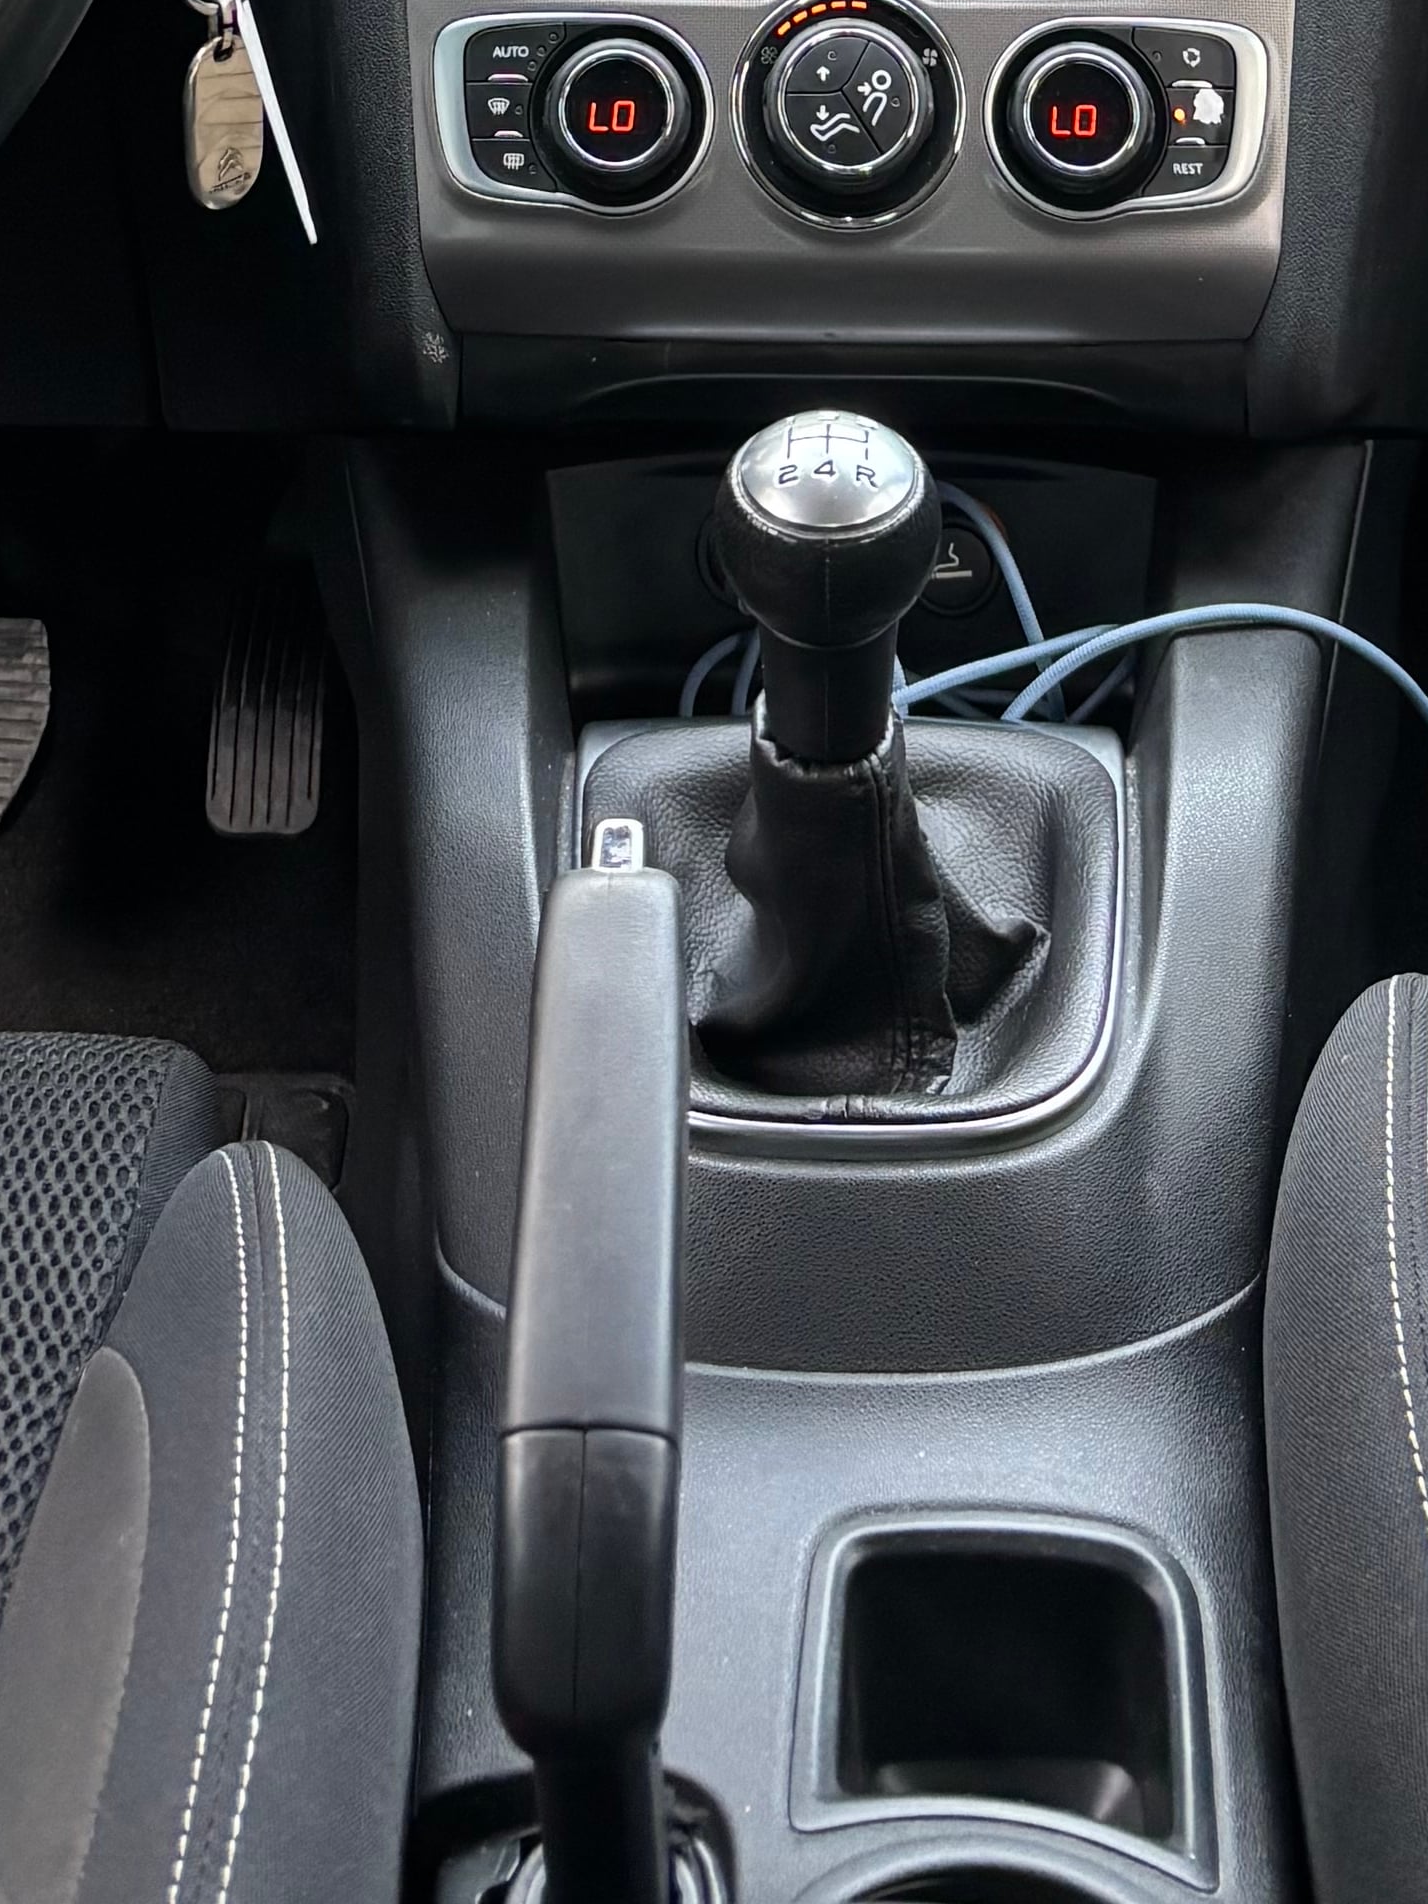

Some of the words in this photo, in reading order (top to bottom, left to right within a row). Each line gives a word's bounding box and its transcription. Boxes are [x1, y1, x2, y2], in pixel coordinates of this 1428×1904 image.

[492, 45, 530, 59] AUTO
[588, 99, 636, 133] LO
[1051, 104, 1098, 137] LO
[1172, 162, 1204, 176] REST
[778, 464, 799, 485] 2
[813, 459, 836, 478] 4
[855, 464, 880, 489] R
